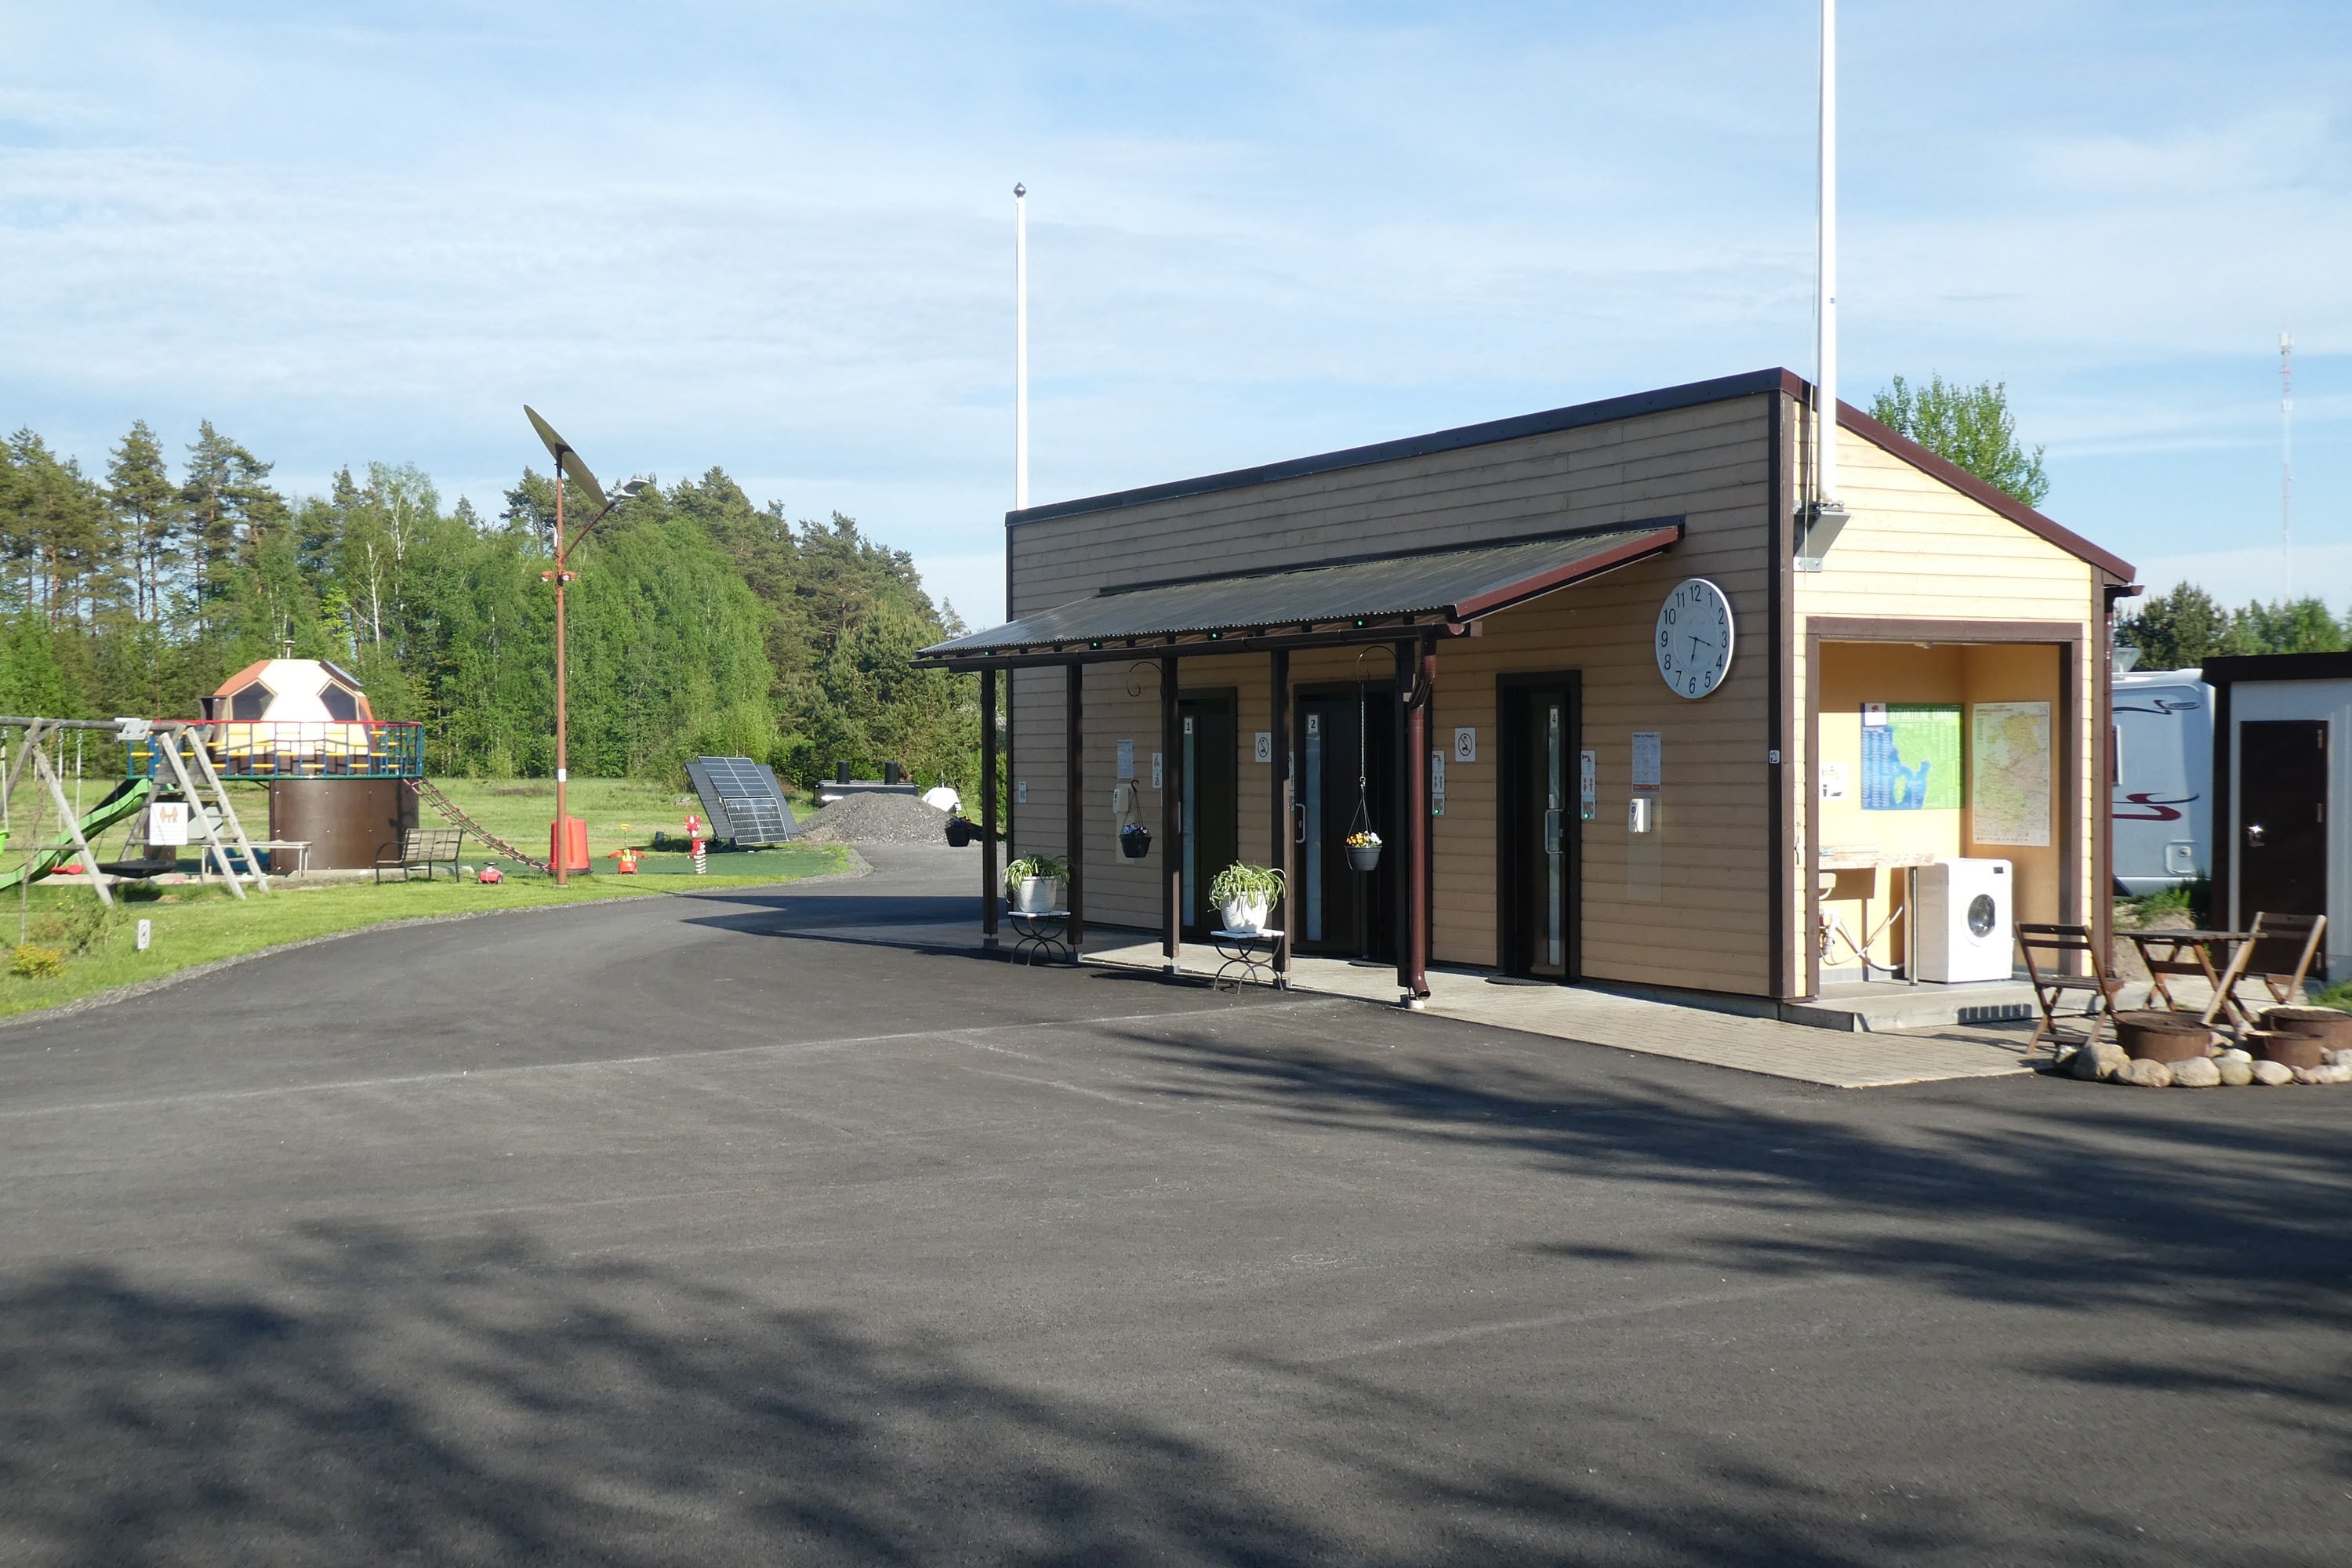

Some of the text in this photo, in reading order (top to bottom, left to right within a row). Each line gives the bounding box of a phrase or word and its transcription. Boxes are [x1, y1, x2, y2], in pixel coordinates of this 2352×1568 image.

[1676, 591, 1685, 608] 11
[1690, 584, 1701, 601] 12
[1708, 591, 1712, 608] 1
[1664, 608, 1676, 625] 10
[1719, 608, 1724, 625] 2
[1661, 630, 1668, 648] 9
[1722, 630, 1727, 648] 3
[1664, 654, 1671, 670] 8
[1716, 654, 1722, 670] 4
[1675, 670, 1682, 687] 7
[1689, 677, 1696, 694] 6
[1704, 671, 1711, 688] 5
[1186, 722, 1191, 731] 1
[1310, 719, 1316, 729] 2
